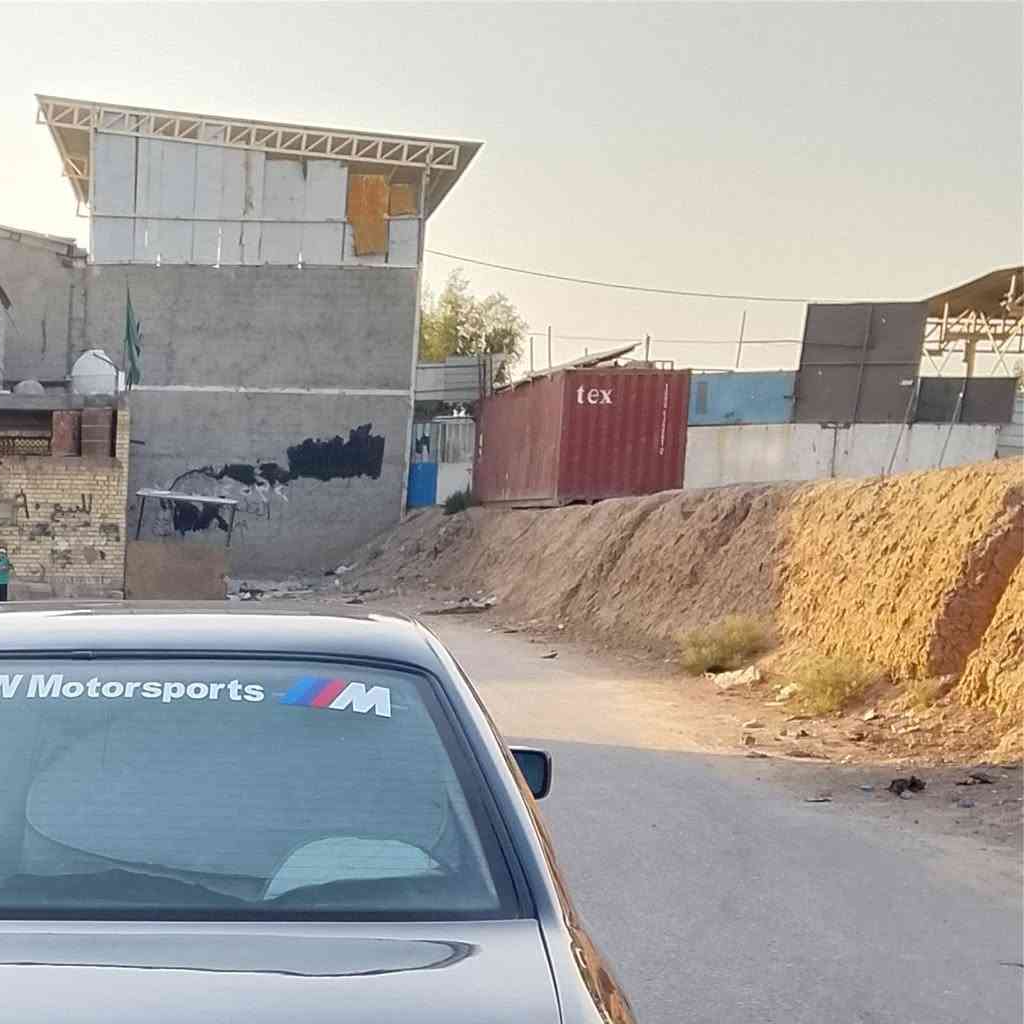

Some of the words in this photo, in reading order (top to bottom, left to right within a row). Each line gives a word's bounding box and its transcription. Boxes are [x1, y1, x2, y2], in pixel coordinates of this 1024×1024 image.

[576, 384, 613, 404] tex
[27, 674, 265, 703] Motorsports
[330, 682, 392, 717] M
